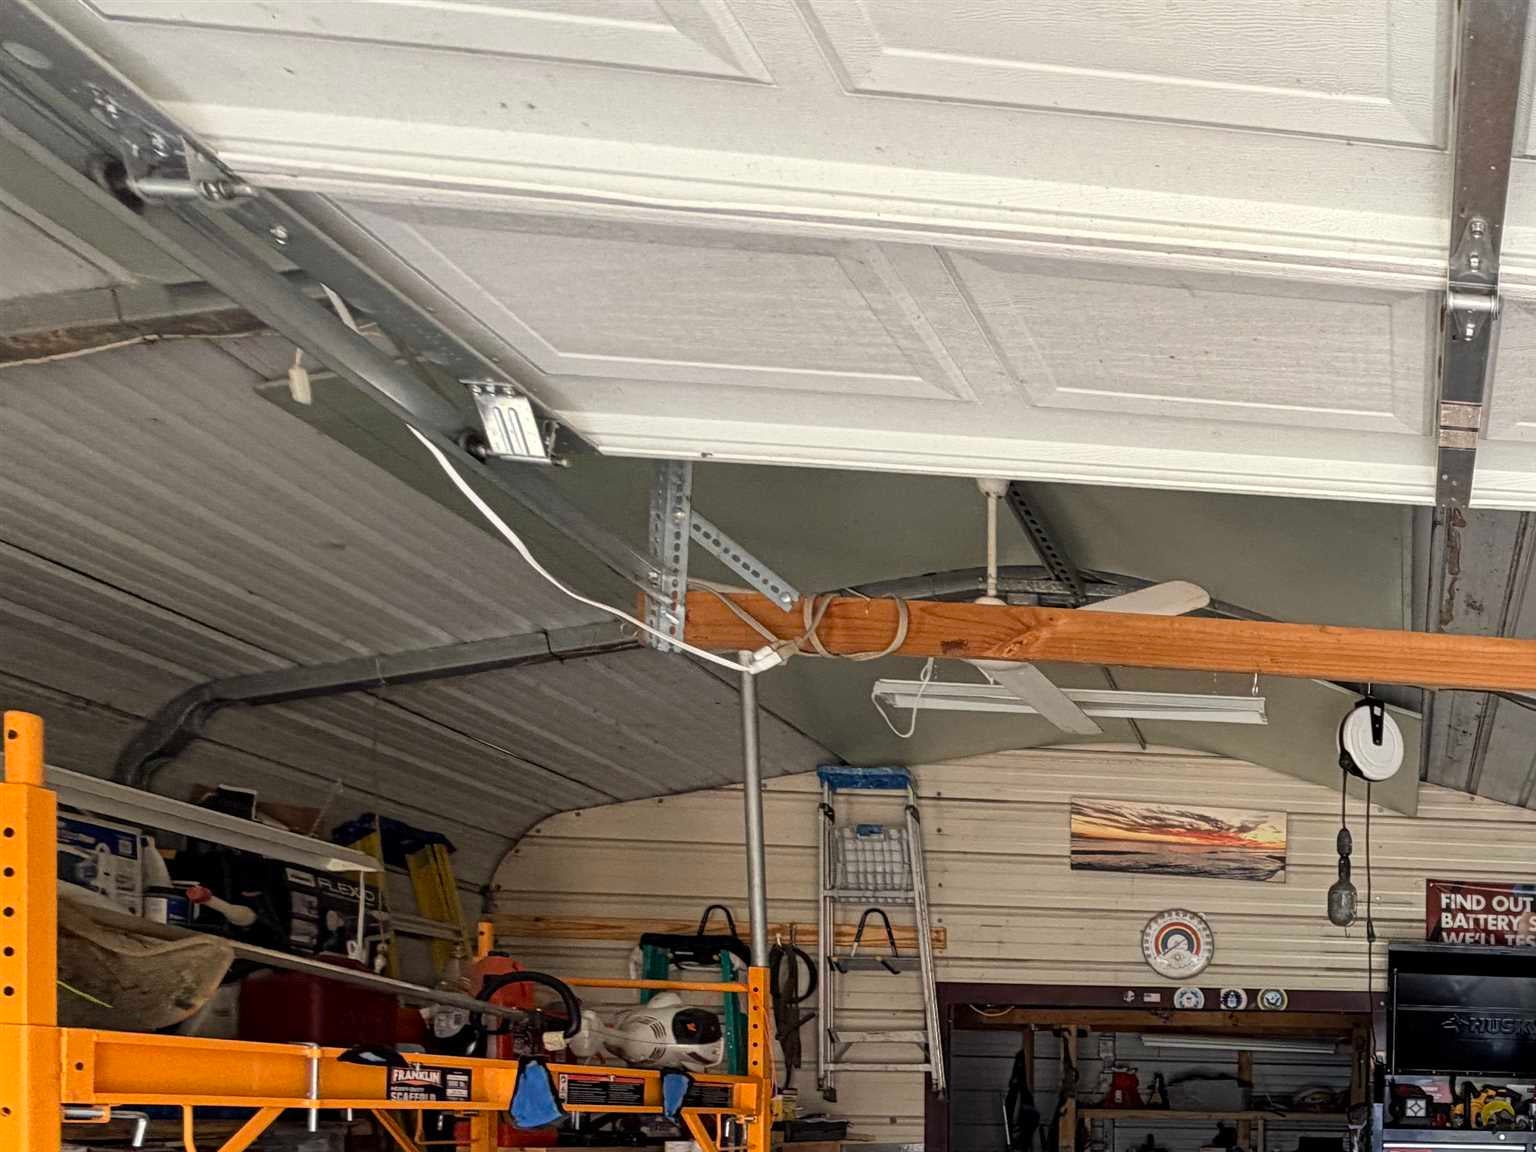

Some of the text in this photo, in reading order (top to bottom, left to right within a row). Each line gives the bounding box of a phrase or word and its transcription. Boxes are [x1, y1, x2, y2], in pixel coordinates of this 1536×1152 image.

[1440, 893, 1486, 911] FIND
[1491, 895, 1533, 913] OUT
[1440, 912, 1521, 931] BATTERY
[393, 1068, 441, 1083] FRANKLIN
